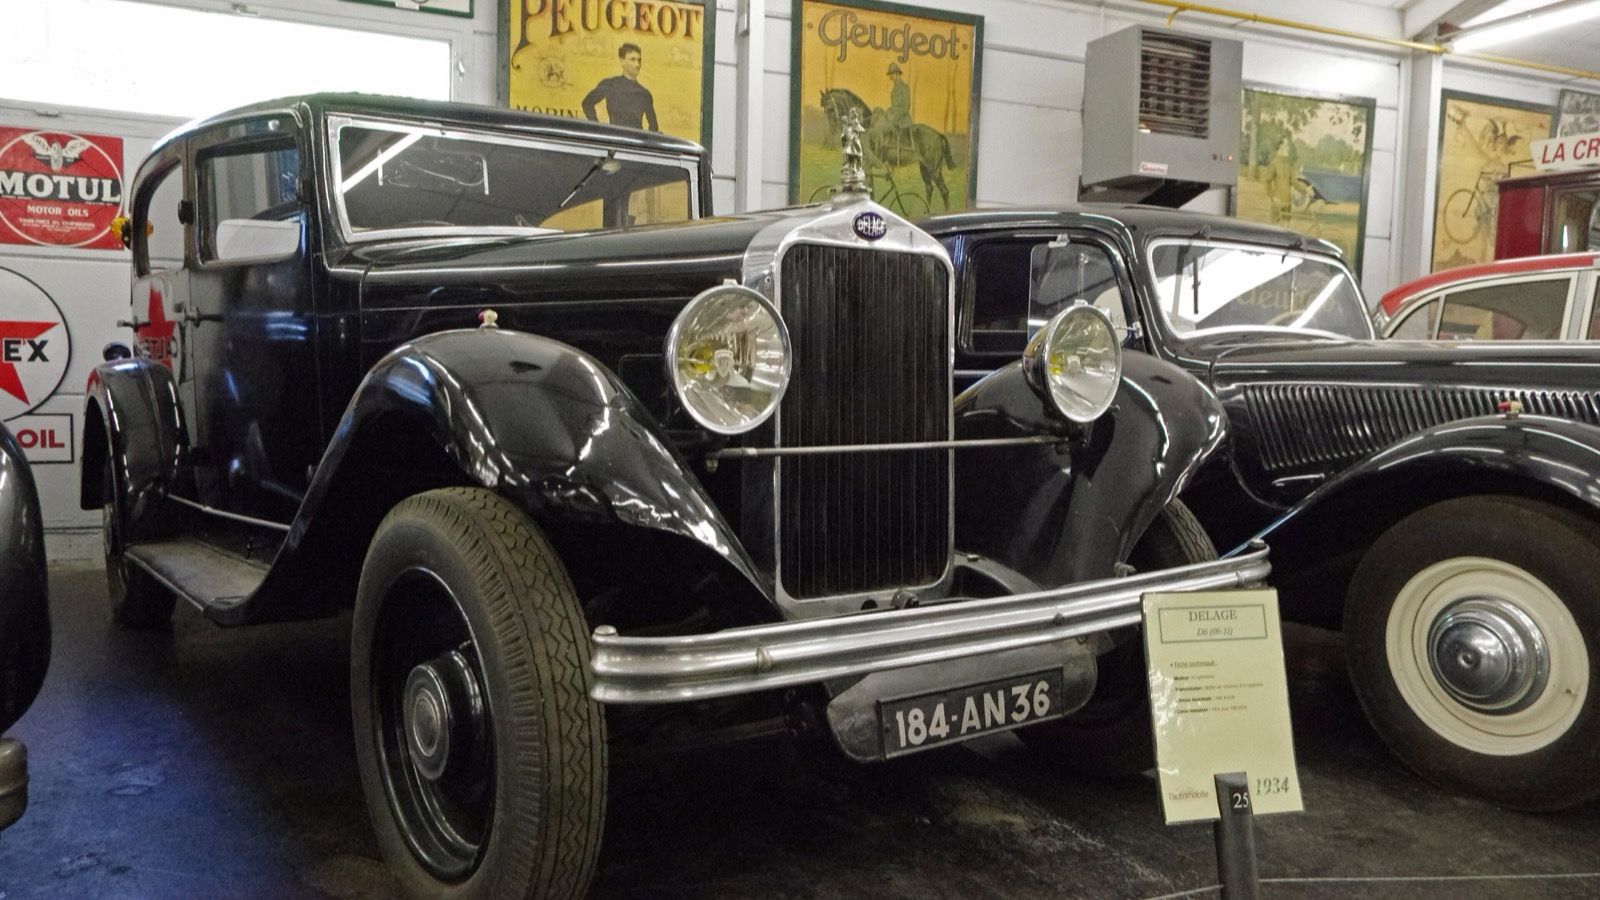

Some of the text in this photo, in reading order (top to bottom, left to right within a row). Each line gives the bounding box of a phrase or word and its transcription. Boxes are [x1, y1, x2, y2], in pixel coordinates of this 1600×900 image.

[511, 0, 700, 69] PEUGEOT
[818, 9, 960, 63] Peugeot
[1541, 142, 1565, 164] LA
[0, 171, 121, 203] MOTUL
[27, 205, 89, 218] MOTOR OILS
[16, 429, 65, 449] OIL
[1189, 609, 1238, 622] DELAGE
[1256, 776, 1290, 796] 1934
[1232, 792, 1249, 809] 25
